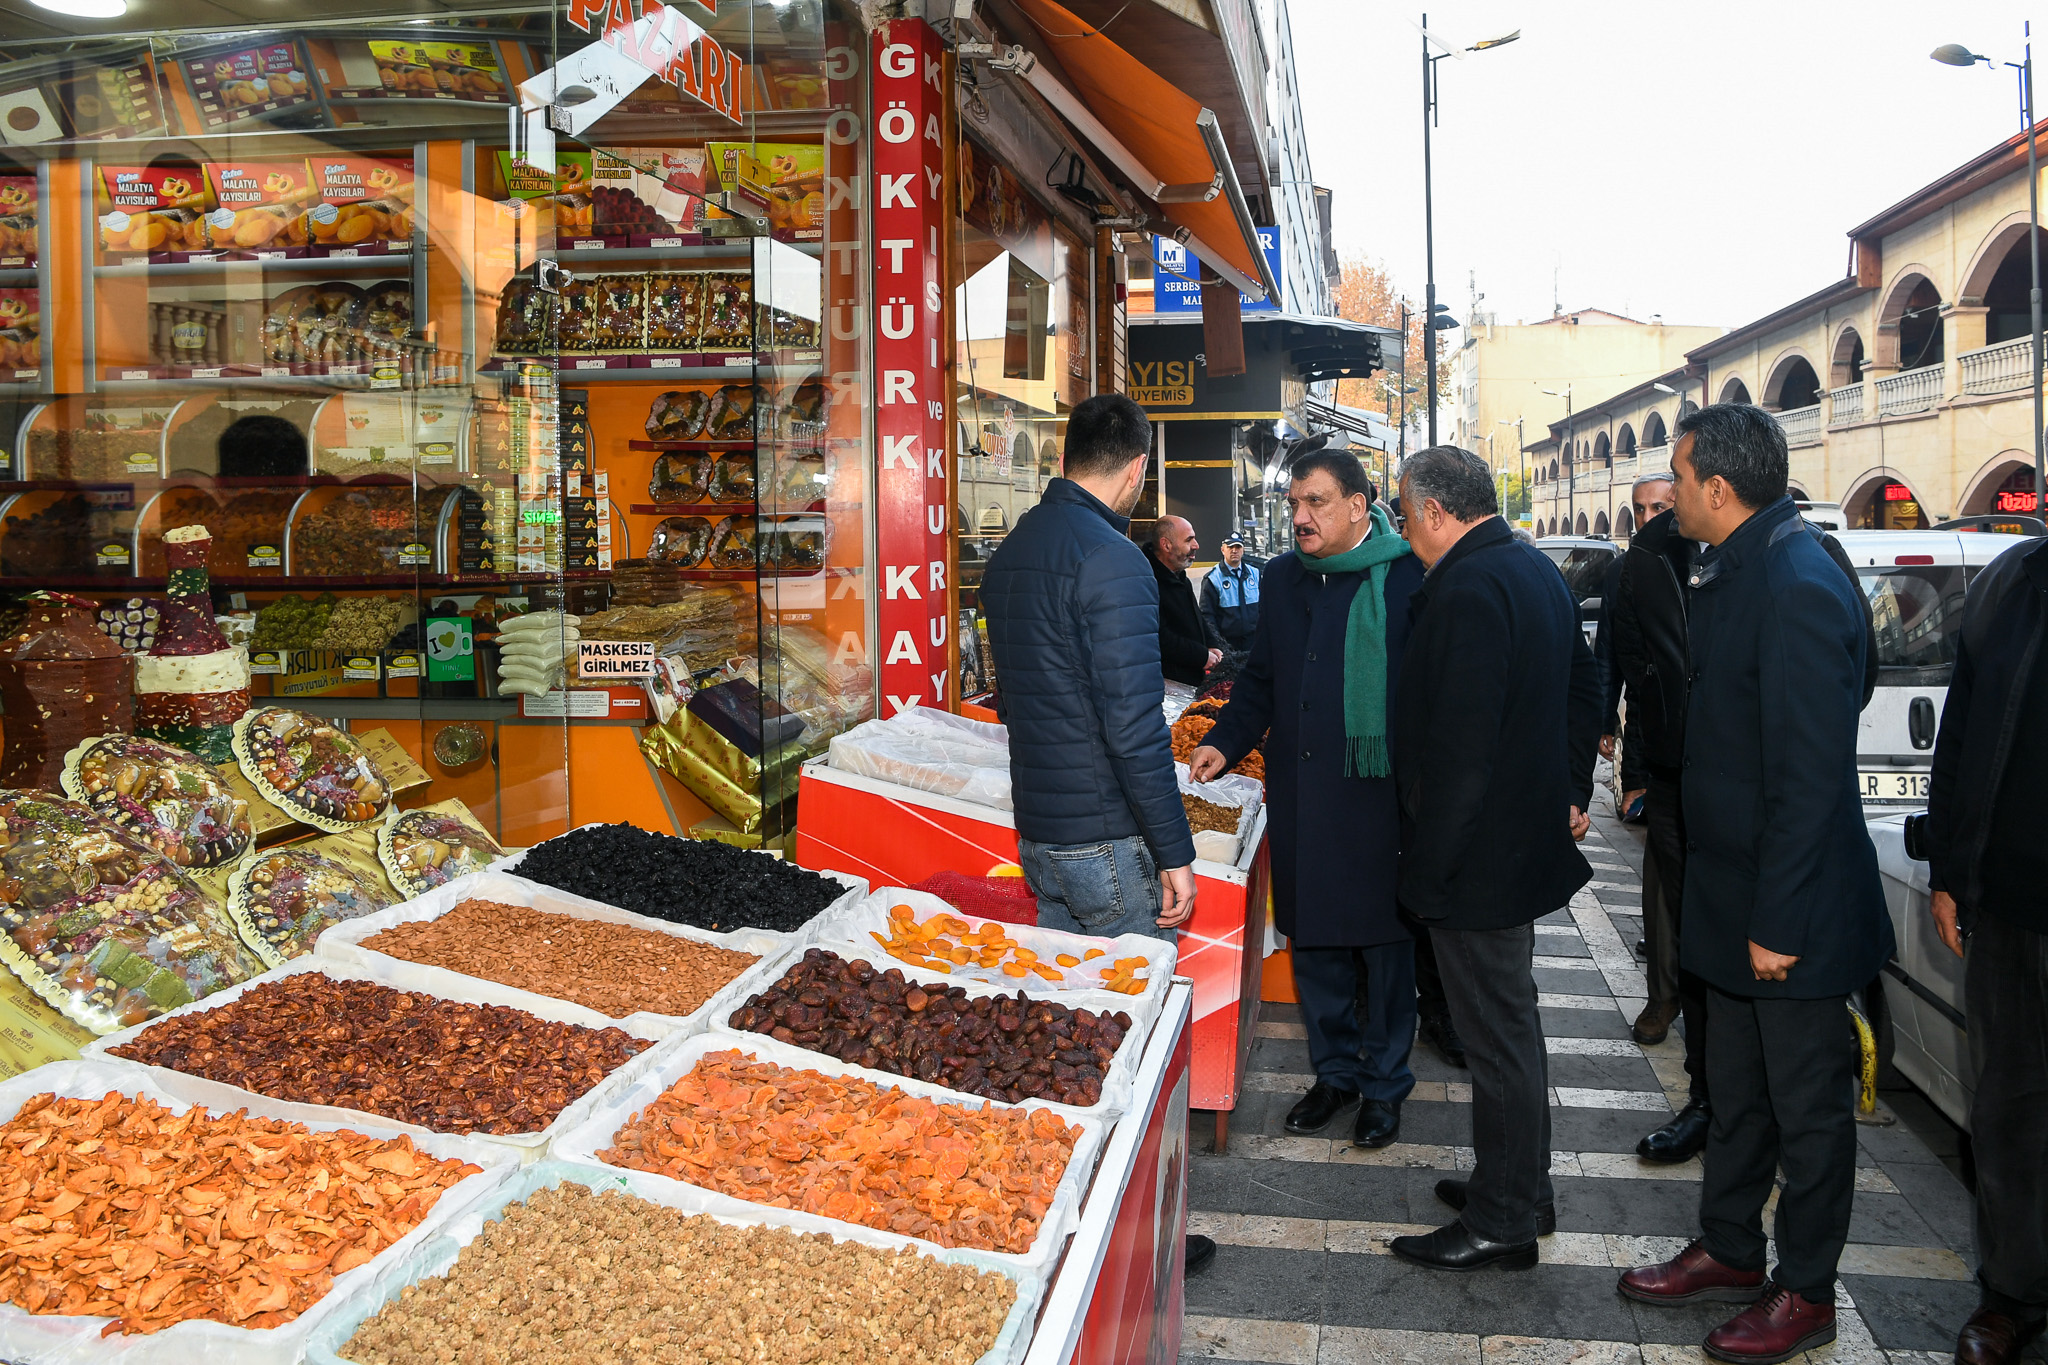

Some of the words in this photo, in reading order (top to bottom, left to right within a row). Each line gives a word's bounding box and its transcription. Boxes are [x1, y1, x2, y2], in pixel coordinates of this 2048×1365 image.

[326, 174, 362, 184] MALATYA
[595, 170, 632, 179] KAYISILARI
[118, 183, 154, 193] MALATYA
[222, 179, 258, 189] MALATYA
[510, 180, 552, 191] KAYISILARI
[220, 192, 262, 202] KAYISILARI
[323, 187, 365, 197] KAYISILARI
[115, 195, 158, 206] KAYISILARI
[923, 52, 943, 369] KAYISI
[878, 43, 919, 470] GÖKTÜRK
[1129, 389, 1186, 401] UYEMiS
[927, 400, 943, 420] ve
[584, 658, 650, 673] GİRİLMEZ
